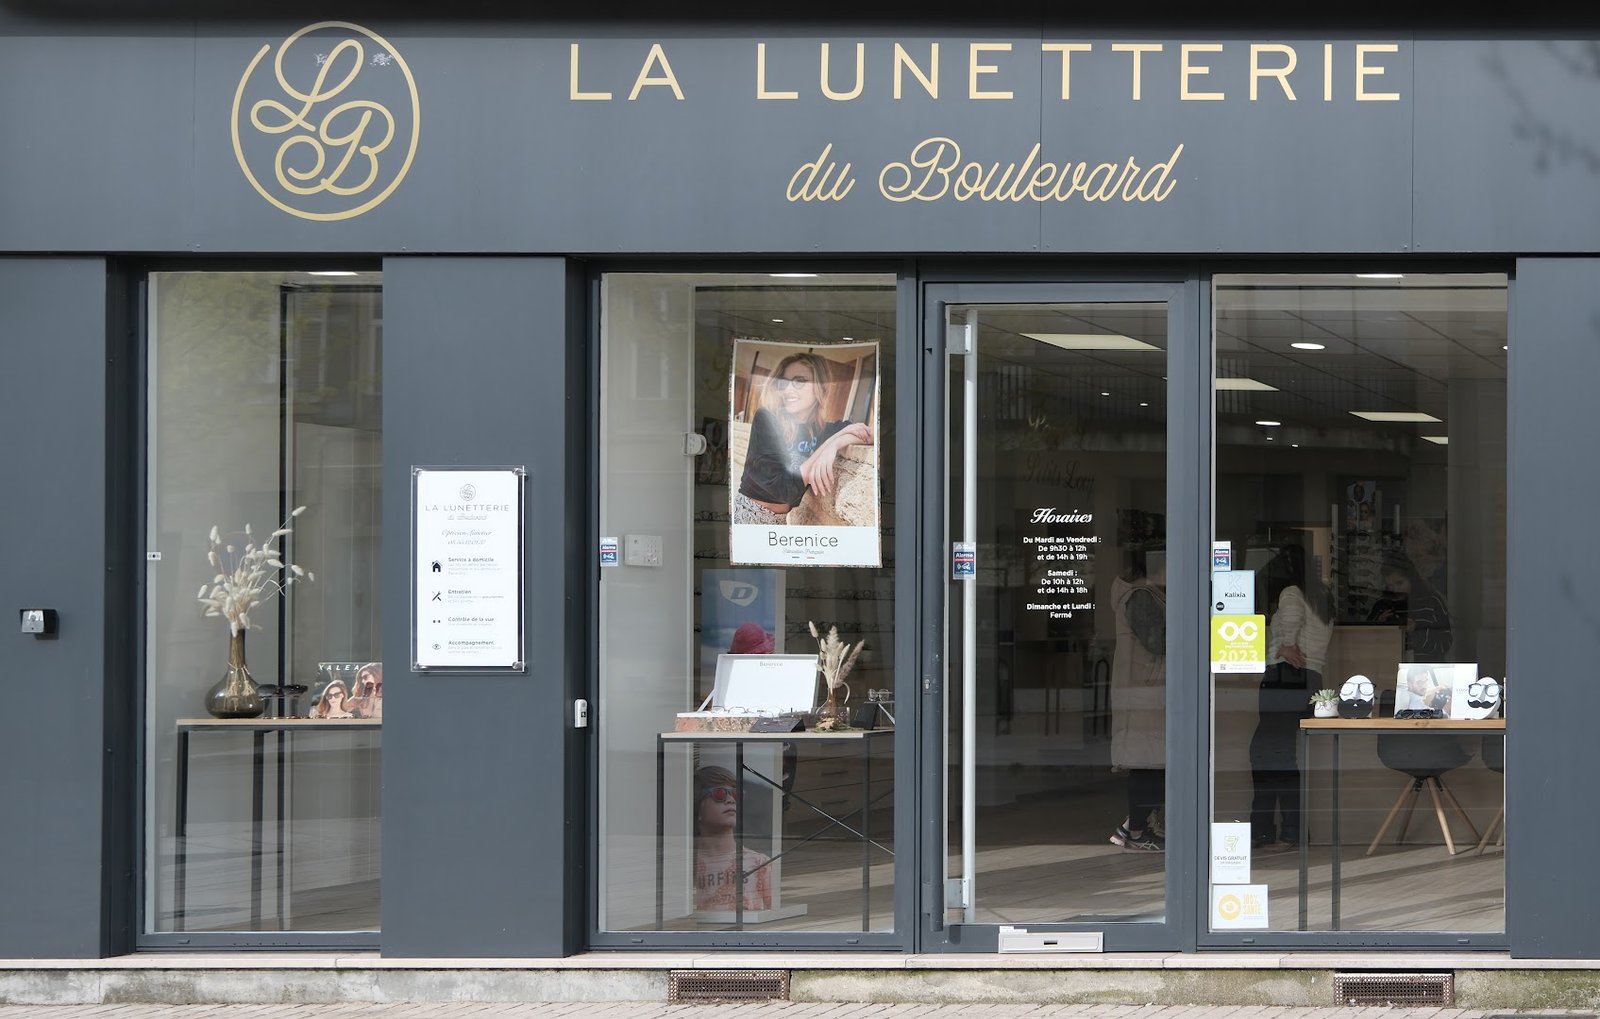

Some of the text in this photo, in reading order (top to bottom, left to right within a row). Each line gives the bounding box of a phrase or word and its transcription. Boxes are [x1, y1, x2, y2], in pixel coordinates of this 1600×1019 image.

[570, 42, 1401, 102] LA LUNETTERIE
[786, 136, 1185, 202] du Boulevard
[425, 504, 510, 512] LA LUNETTERIE
[1030, 508, 1093, 524] Horaires
[768, 531, 839, 548] Berenice
[1023, 536, 1034, 544] Du
[1034, 536, 1055, 544] Mardi
[1066, 536, 1097, 544] Vendredi
[1069, 544, 1074, 552] à
[1037, 553, 1045, 561] et
[1046, 553, 1056, 561] de
[1069, 552, 1075, 561] à
[1075, 553, 1088, 561] 19h
[1047, 569, 1074, 577] Samedi
[1041, 578, 1051, 586] De
[1066, 577, 1071, 585] à
[1046, 586, 1056, 594] de
[1056, 586, 1069, 594] 14h
[1069, 586, 1075, 594] à
[1075, 586, 1088, 594] 18h
[1026, 602, 1062, 610] Dimanche
[1071, 602, 1091, 610] Lundi
[1049, 611, 1073, 619] Fermé
[1218, 650, 1259, 662] 2023
